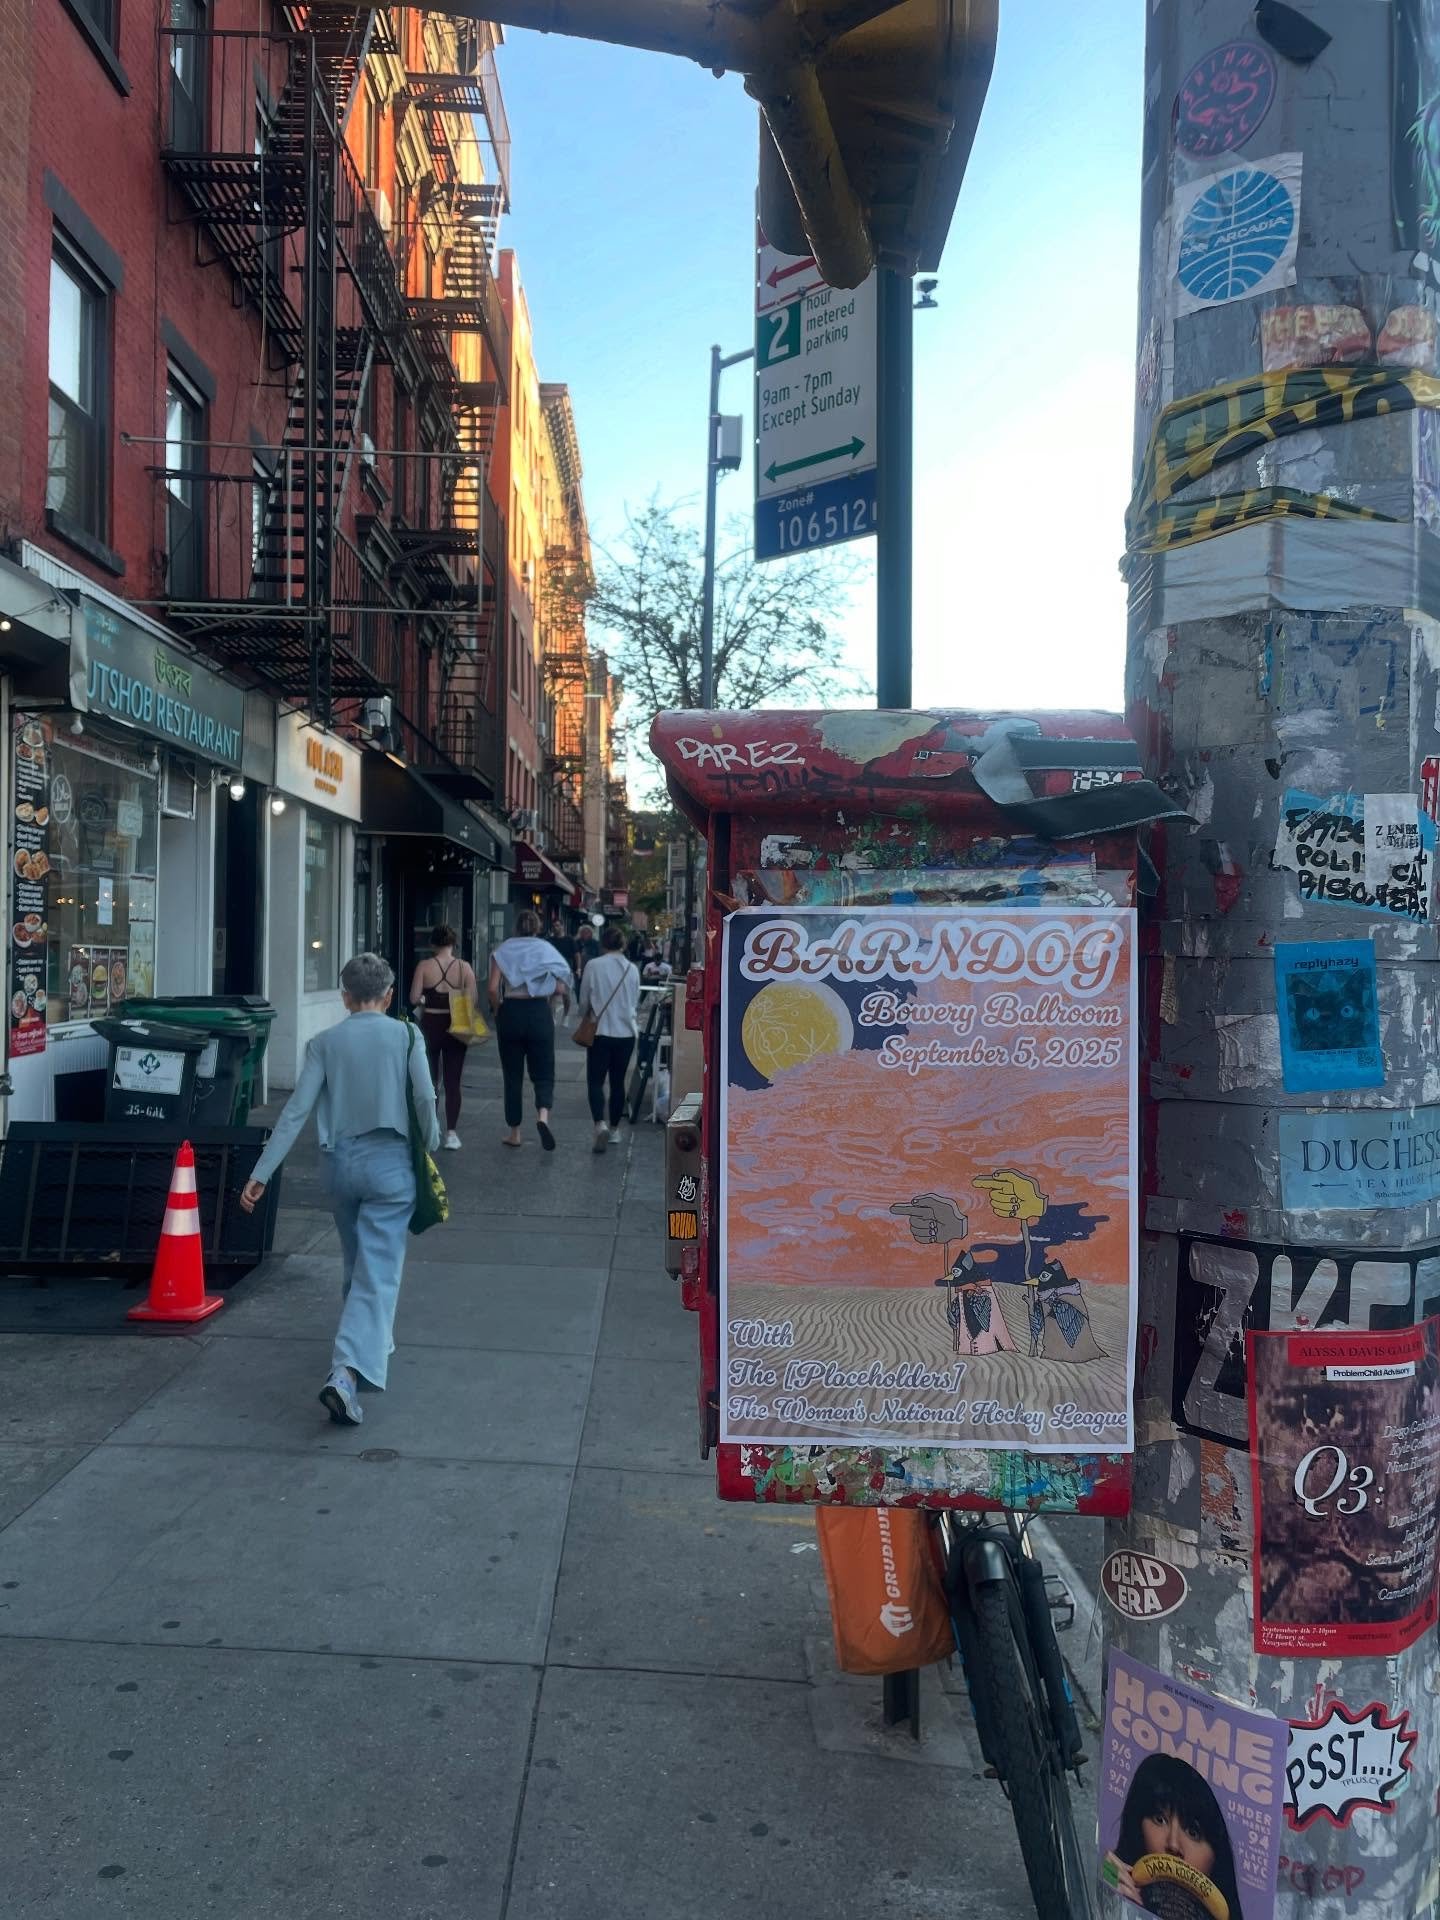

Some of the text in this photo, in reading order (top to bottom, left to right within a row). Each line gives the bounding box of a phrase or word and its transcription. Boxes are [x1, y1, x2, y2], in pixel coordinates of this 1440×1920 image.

[1213, 216, 1288, 249] ARCADIA
[806, 289, 832, 312] hour
[806, 298, 855, 332] metered
[768, 308, 790, 360] 2
[806, 324, 849, 355] parking
[762, 386, 790, 408] 9am
[803, 367, 833, 398] 7pm
[762, 384, 861, 432] Except Sunday
[777, 492, 815, 514] Zone#
[156, 692, 240, 761] RESTAURANT
[747, 926, 1116, 990] BARNDOG
[1294, 957, 1359, 970] replyhazy
[861, 994, 1119, 1033] Bowery Ballroom
[879, 1036, 1119, 1074] September 5, 2025
[730, 1320, 794, 1347] With
[1301, 1346, 1345, 1357] ALYSSA
[1349, 1346, 1385, 1357] DAVIS
[730, 1359, 966, 1392] The [Placeholders]
[1333, 1367, 1410, 1377] ProblemChild Advisory
[730, 1397, 1128, 1435] The Women's National Hockey League
[1294, 1445, 1384, 1516] Q3:
[1111, 1555, 1166, 1587] DEAD
[1118, 1584, 1163, 1614] ERA
[1262, 1626, 1299, 1635] September
[1275, 1633, 1297, 1641] Henry
[1114, 1667, 1274, 1775] HOME
[1111, 1739, 1132, 1760] 9/6
[1112, 1707, 1274, 1806] COMING
[1108, 1769, 1128, 1788] 9/7
[1228, 1799, 1272, 1826] UNDER
[1248, 1830, 1269, 1850] 94
[1145, 1861, 1172, 1878] DARA
[1243, 1859, 1268, 1879] NYC
